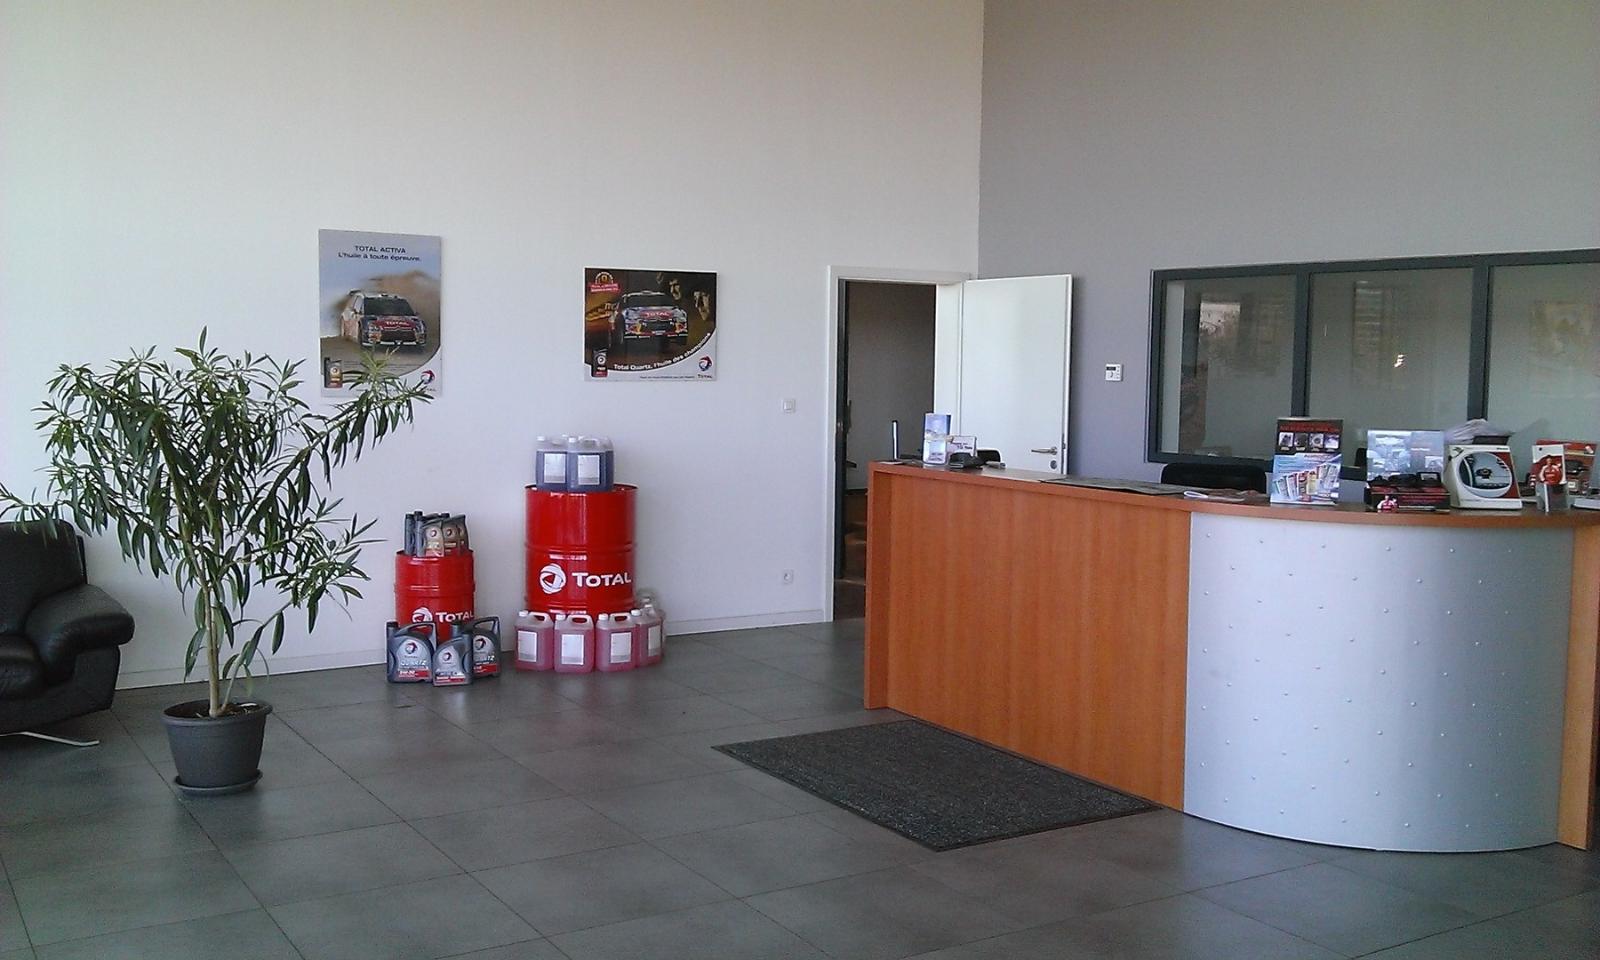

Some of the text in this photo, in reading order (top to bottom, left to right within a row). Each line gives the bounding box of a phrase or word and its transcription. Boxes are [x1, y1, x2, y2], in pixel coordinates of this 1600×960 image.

[354, 245, 379, 253] TOTAL
[614, 363, 630, 371] Total
[672, 354, 685, 363] des
[572, 571, 632, 589] TOTAL
[435, 610, 475, 623] TOTAL
